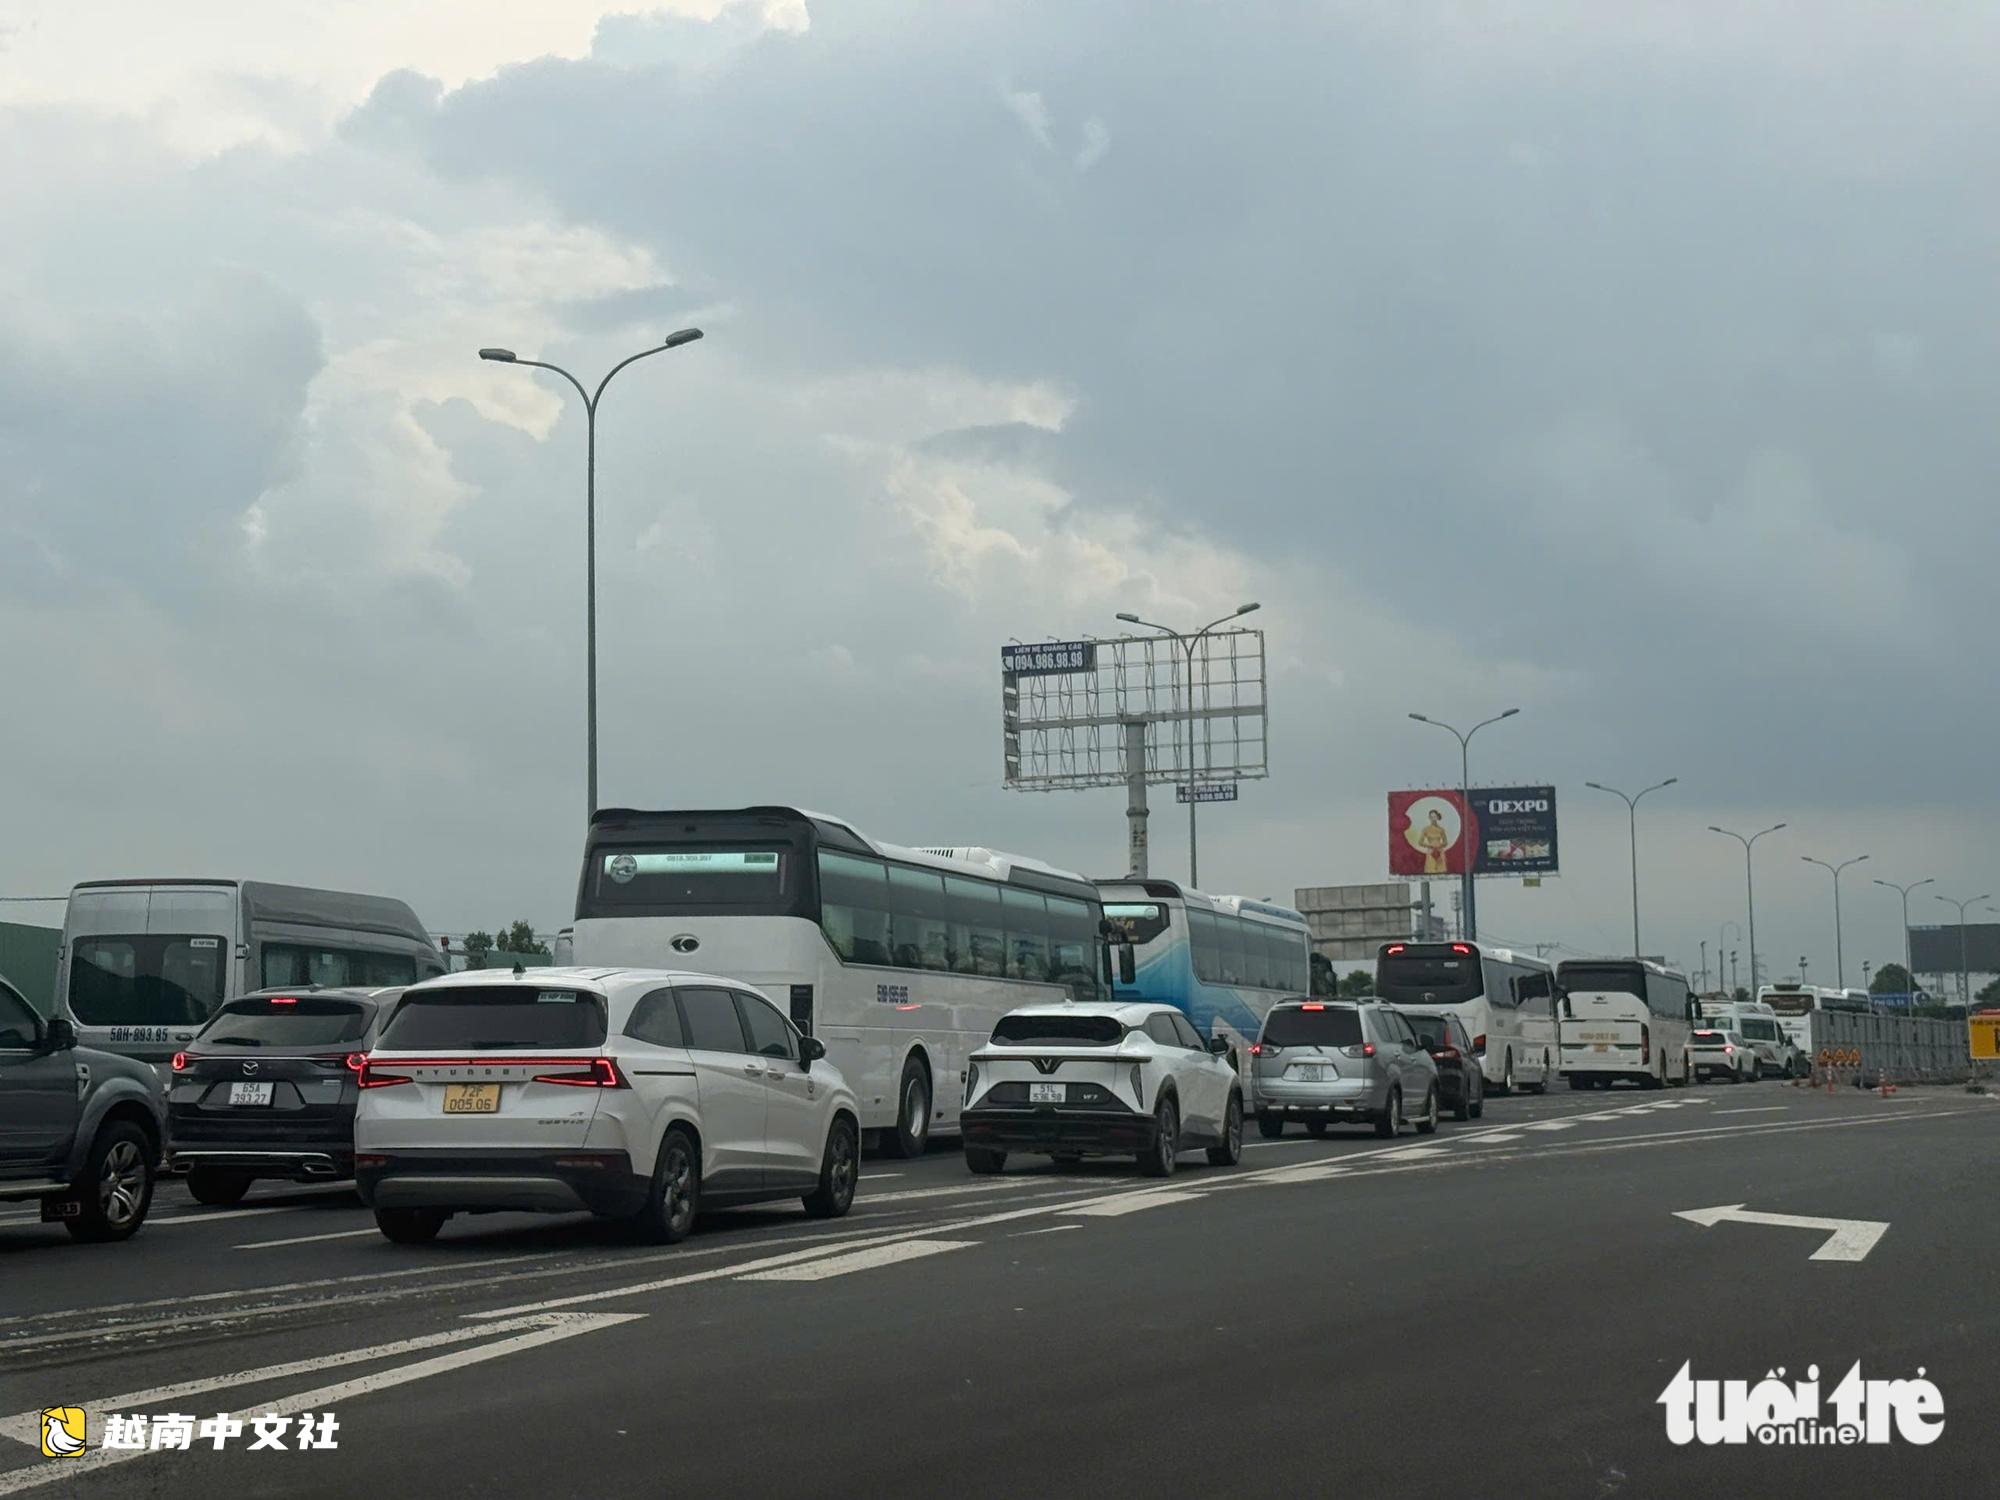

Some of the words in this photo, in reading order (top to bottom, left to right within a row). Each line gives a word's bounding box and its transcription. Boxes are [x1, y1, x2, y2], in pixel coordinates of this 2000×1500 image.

[1014, 651, 1083, 671] 094.986.98.98
[1488, 799, 1548, 815] OEXPO
[416, 1068, 527, 1076] HYUNDAI
[243, 1082, 261, 1093] 65A
[461, 1084, 483, 1098] 72F
[449, 1098, 492, 1111] 005.06
